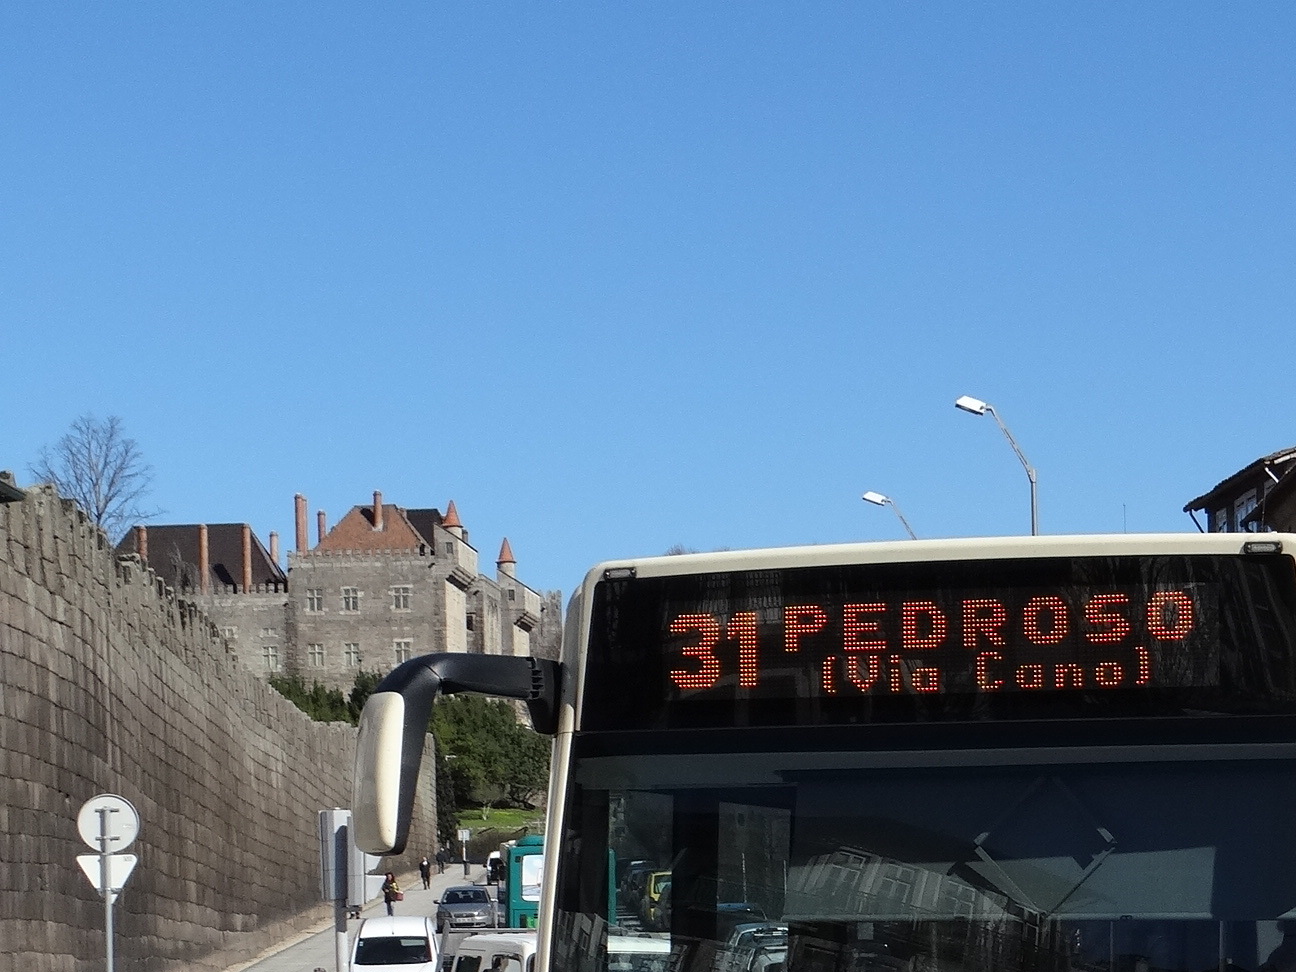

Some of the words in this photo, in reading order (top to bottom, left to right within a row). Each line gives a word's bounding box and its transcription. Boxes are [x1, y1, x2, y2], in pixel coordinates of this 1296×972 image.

[667, 610, 758, 689] 31
[782, 590, 1196, 653] PEDROSO
[821, 653, 940, 695] (Via
[975, 646, 1151, 691] Cano)
